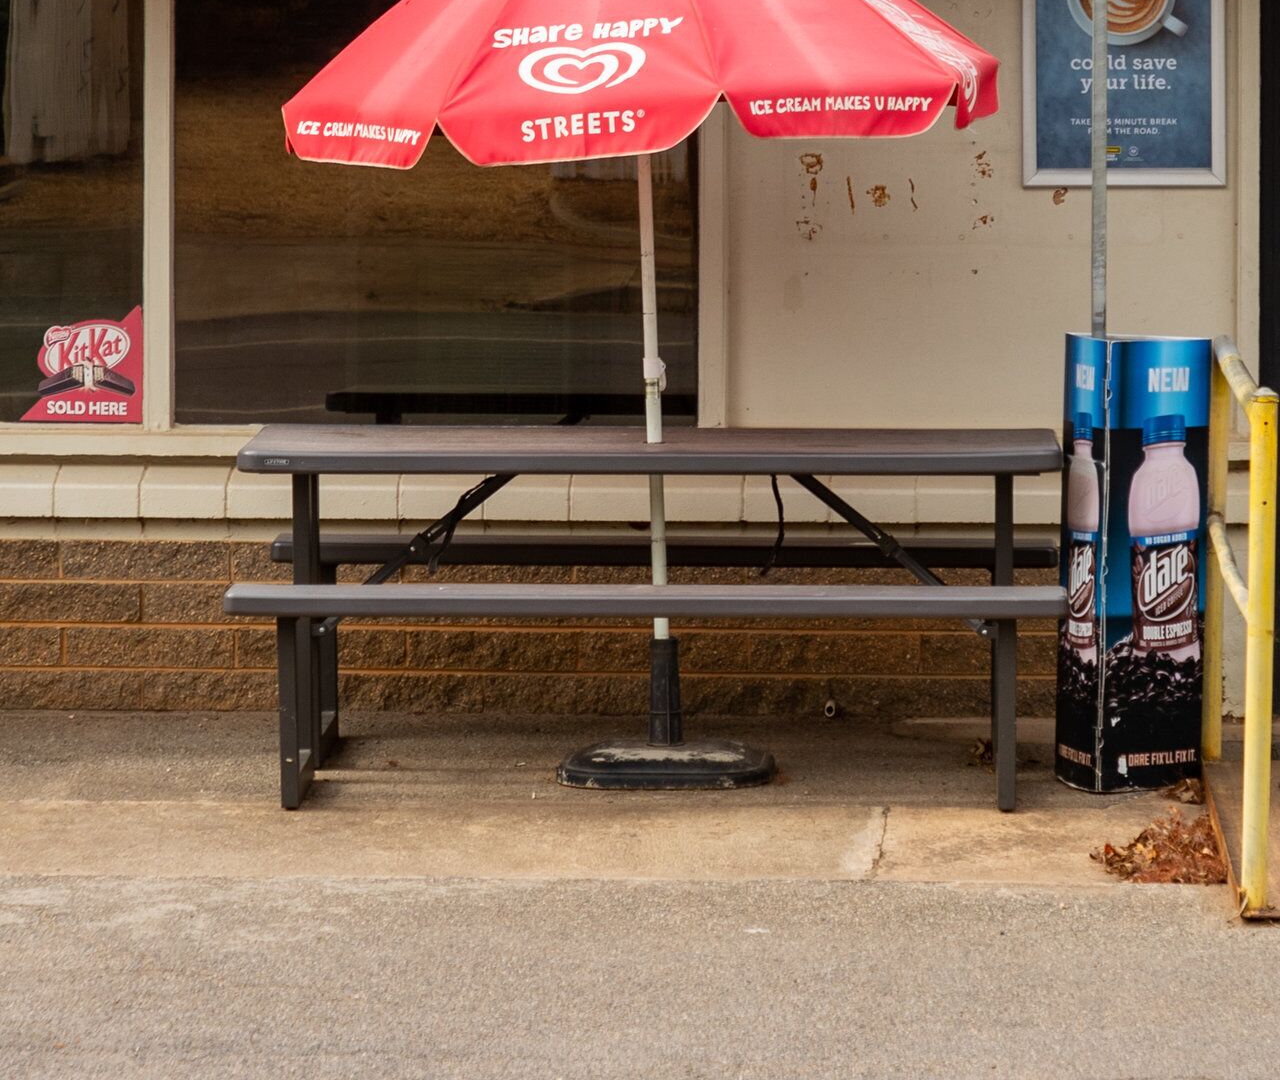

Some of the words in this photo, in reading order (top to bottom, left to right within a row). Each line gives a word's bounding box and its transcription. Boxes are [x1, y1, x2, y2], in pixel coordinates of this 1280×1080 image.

[1070, 54, 1126, 71] cold
[1132, 57, 1178, 71] save
[1080, 77, 1128, 95] yur
[1133, 74, 1172, 91] life.
[749, 99, 774, 116] ICE
[776, 97, 822, 114] CREAM
[825, 95, 871, 111] MAKES
[874, 96, 885, 112] U
[887, 96, 933, 112] HAPPY
[297, 120, 321, 136] ICE
[323, 122, 354, 137] CREAM
[354, 122, 386, 140] MAKES
[387, 127, 395, 143] U
[1070, 117, 1092, 126] TAKE
[1114, 117, 1149, 126] MINUTE
[1150, 117, 1178, 126] BREAK
[1114, 127, 1132, 136] THE
[1133, 127, 1161, 137] ROAD.
[58, 327, 122, 371] KitKat
[1075, 363, 1095, 392] NEW
[1148, 367, 1190, 393] NEW
[46, 400, 86, 415] SOLD
[88, 401, 128, 416] HERE
[1153, 534, 1171, 545] SUGAR
[1171, 532, 1188, 543] ADDED
[1144, 543, 1189, 604] dare
[1143, 625, 1165, 640] DOUBLE
[1165, 620, 1193, 639] ESPRESSO
[1128, 753, 1150, 767] DARE
[1151, 751, 1174, 766] FIX'LL
[1175, 750, 1188, 764] FIX
[1187, 749, 1198, 762] IT.
